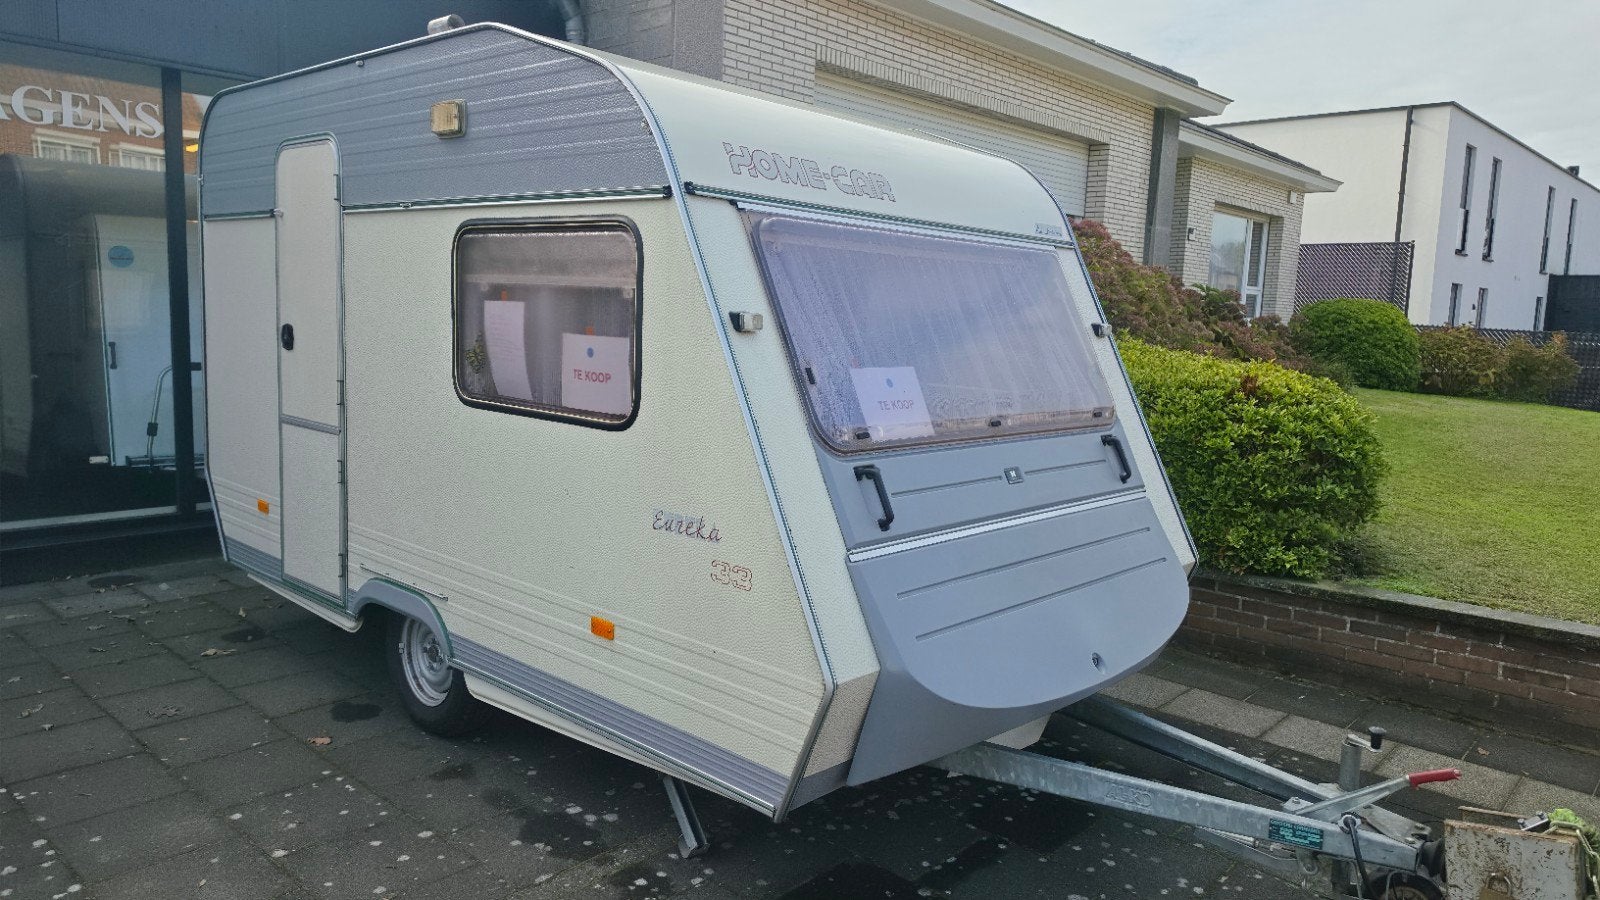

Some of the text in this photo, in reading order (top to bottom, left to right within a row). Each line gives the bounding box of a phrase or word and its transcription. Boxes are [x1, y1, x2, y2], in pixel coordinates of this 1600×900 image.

[722, 141, 896, 202] HOME-CAR
[573, 368, 612, 383] TE KOOP
[878, 399, 914, 411] TE KOOP
[652, 509, 722, 541] Eureka
[711, 559, 753, 591] 33
